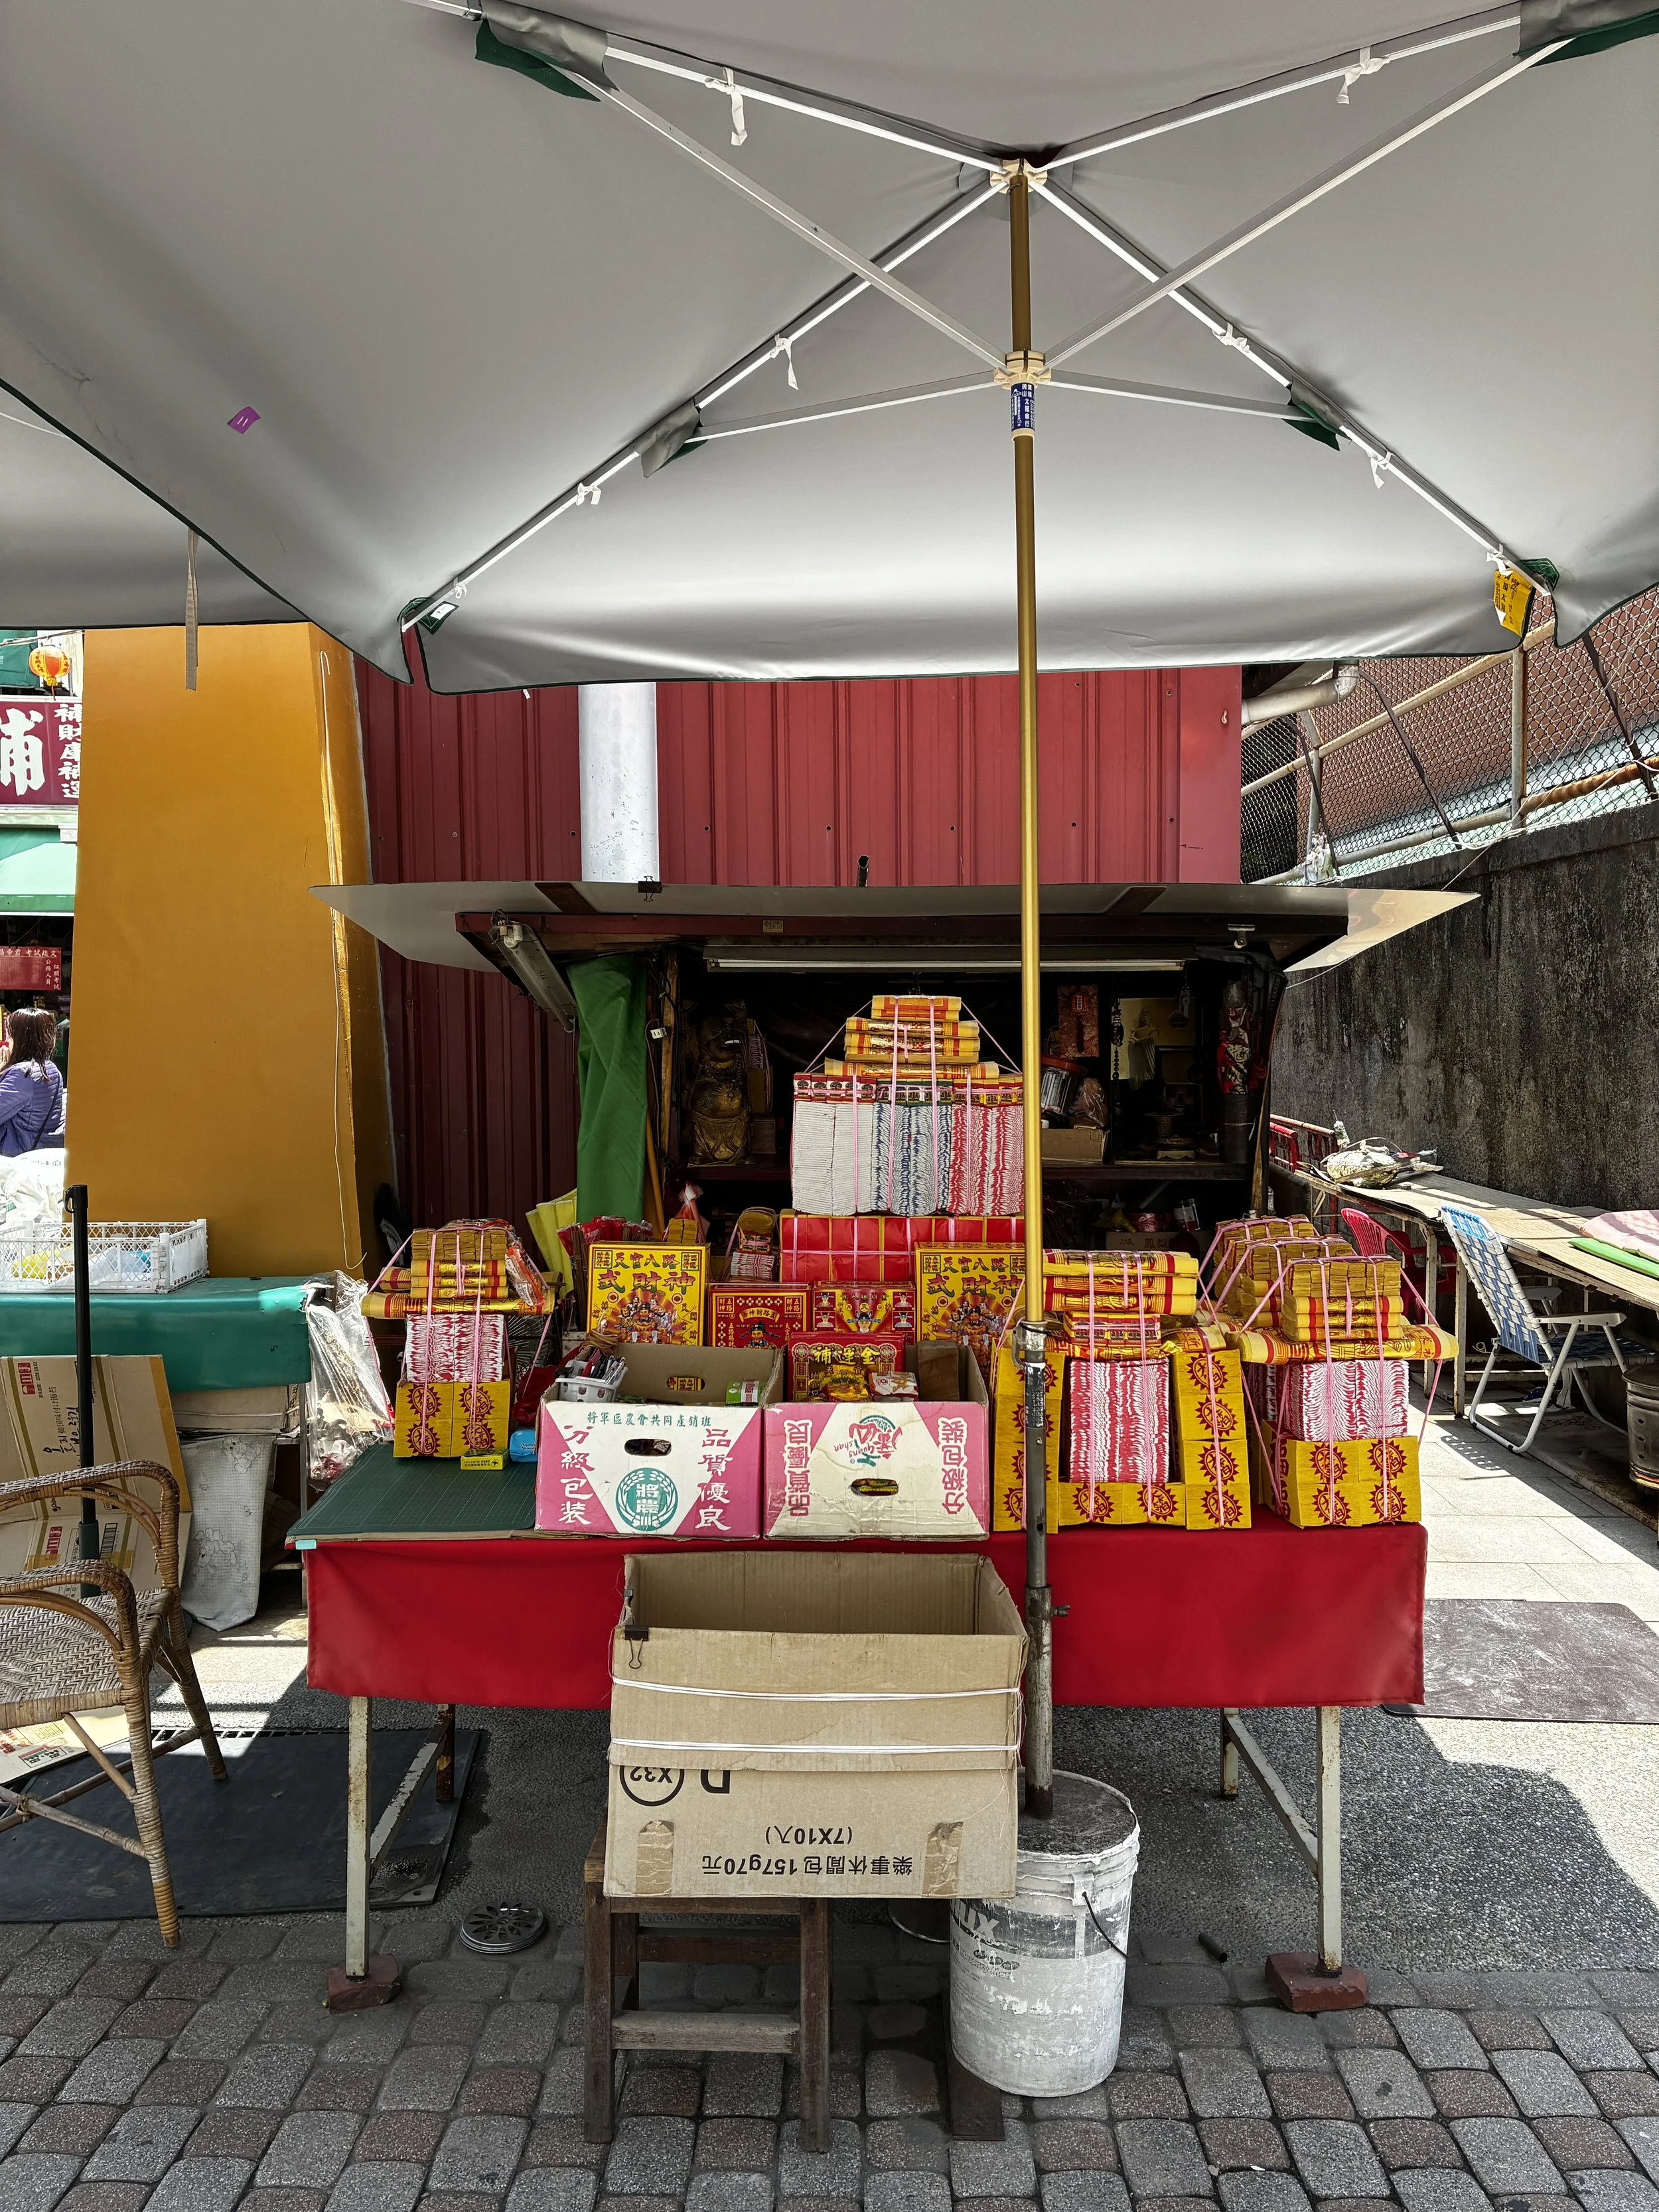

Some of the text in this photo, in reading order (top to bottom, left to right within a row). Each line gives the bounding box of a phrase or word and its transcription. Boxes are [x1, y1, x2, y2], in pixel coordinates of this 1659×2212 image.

[613, 1252, 680, 1269] 天官八路
[942, 1256, 1009, 1273] 天官八路
[597, 1269, 695, 1295] 武財神
[926, 1274, 1025, 1297] 武財神
[814, 1347, 880, 1365] 補運金
[587, 1412, 711, 1427] 將軍區農會共同產銷班
[833, 1441, 853, 1452] shan
[558, 1425, 595, 1525] 分級包裝
[695, 1428, 733, 1530] 品質優良
[765, 1826, 853, 1845] (7X10入)
